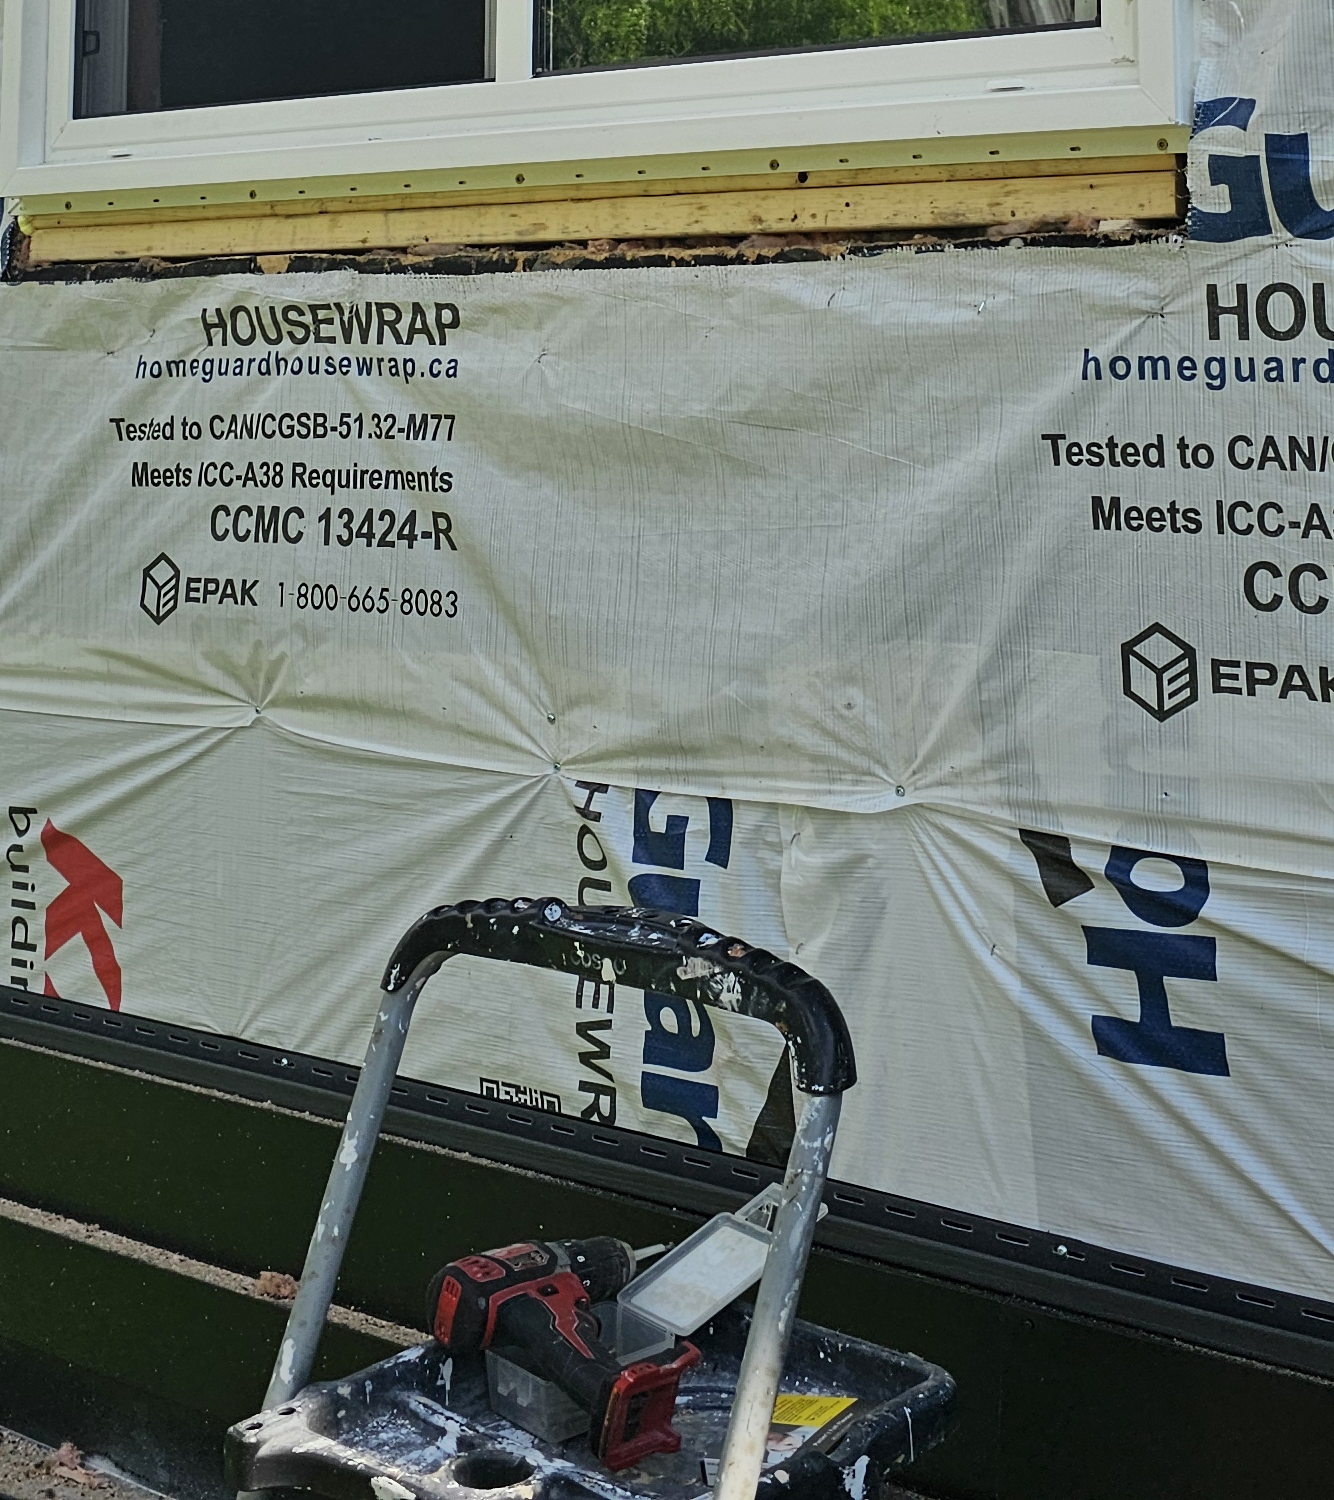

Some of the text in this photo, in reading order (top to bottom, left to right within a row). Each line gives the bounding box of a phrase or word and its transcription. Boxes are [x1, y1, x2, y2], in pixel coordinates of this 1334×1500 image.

[201, 302, 460, 347] HOUSEWRAP
[135, 351, 459, 384] homeguardhousewrap.ca
[109, 412, 456, 442] Tested to CAN/CGSB-51.32-M77
[1041, 434, 1166, 469] Tested
[1178, 435, 1214, 470] to
[131, 462, 454, 496] Meets ICC-A38 Requirements
[210, 504, 458, 551] CCMC 13424-R
[1091, 496, 1203, 535] Meets
[185, 576, 458, 618] EPAK 1-800-665-8083
